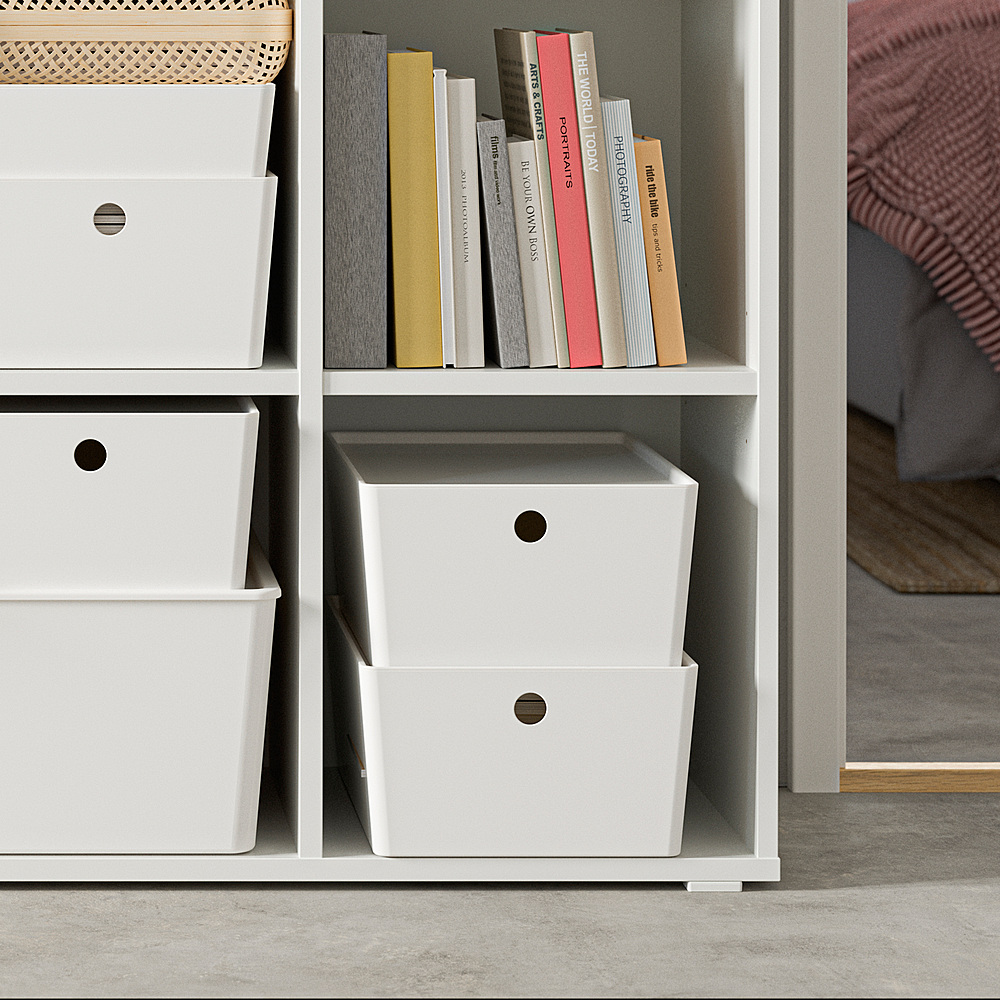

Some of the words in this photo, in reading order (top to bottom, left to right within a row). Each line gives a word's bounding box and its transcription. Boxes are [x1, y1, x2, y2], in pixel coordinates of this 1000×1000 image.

[577, 51, 589, 75] THE
[529, 63, 539, 89] ARTS
[579, 77, 594, 123] WORLD
[533, 101, 545, 140] CRAFTS
[490, 136, 500, 159] films
[559, 116, 573, 189] PORTRAITS
[584, 131, 599, 172] TODAY
[521, 160, 531, 172] BE
[645, 165, 655, 182] ride
[522, 175, 532, 203] YOUR
[613, 135, 632, 224] PHOTOGRAPHY
[647, 183, 657, 198] the
[525, 205, 536, 234] OWN
[649, 199, 659, 218] bike
[461, 195, 469, 263] PHOTOALBUM
[651, 223, 659, 236] tips
[529, 237, 539, 262] BOSS
[653, 238, 661, 251] and
[656, 253, 664, 272] tricks
